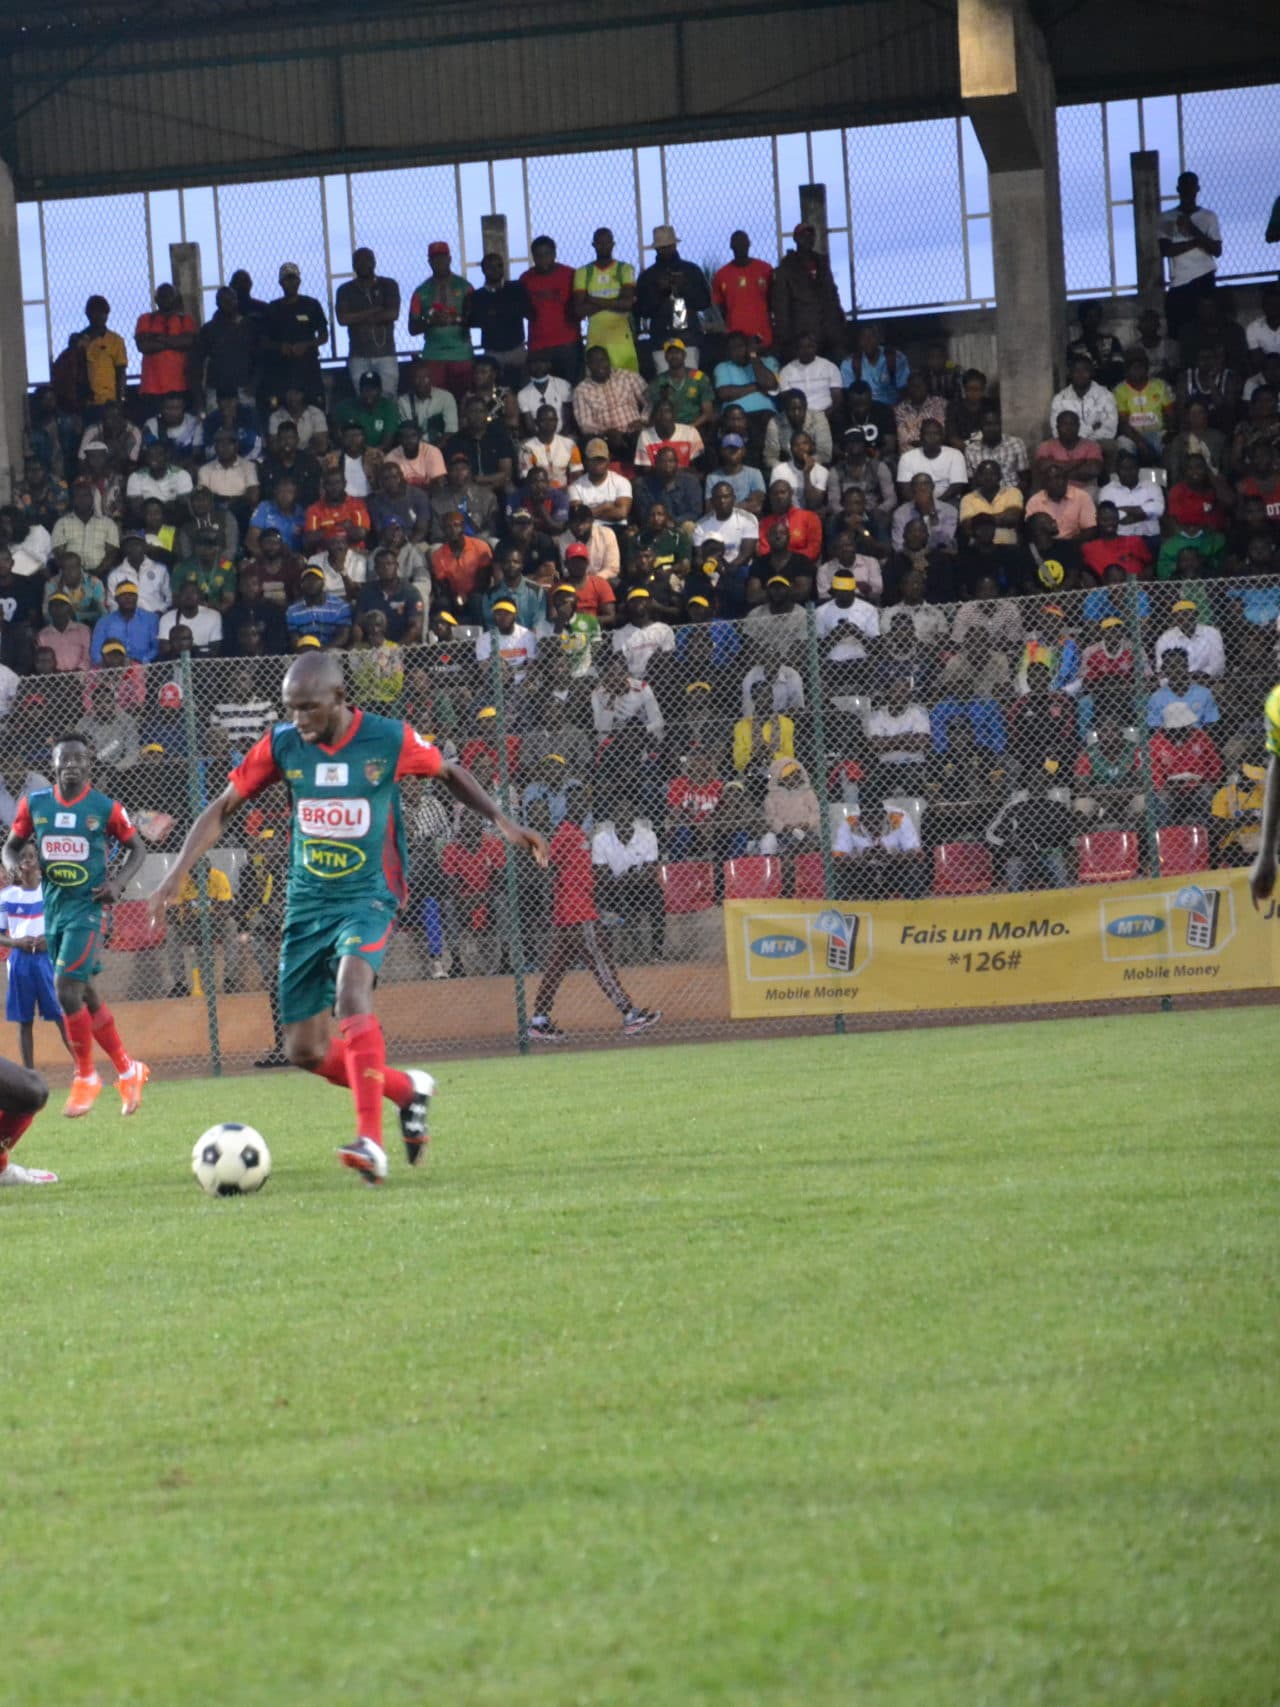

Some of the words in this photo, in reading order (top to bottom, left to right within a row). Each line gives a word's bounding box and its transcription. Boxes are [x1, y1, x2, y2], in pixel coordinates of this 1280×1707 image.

[302, 807, 363, 826] BROLI
[46, 841, 84, 854] BROLI
[310, 848, 348, 868] MTN
[53, 868, 77, 880] MTN
[900, 925, 947, 944] Fais
[952, 927, 983, 943] un
[988, 919, 1071, 941] MoMo.
[1117, 919, 1156, 935] MTN
[759, 940, 797, 955] MTN
[1123, 966, 1170, 981] Mobile
[1173, 963, 1220, 978] Money
[765, 986, 810, 1000] Mobile
[814, 985, 859, 999] Money
